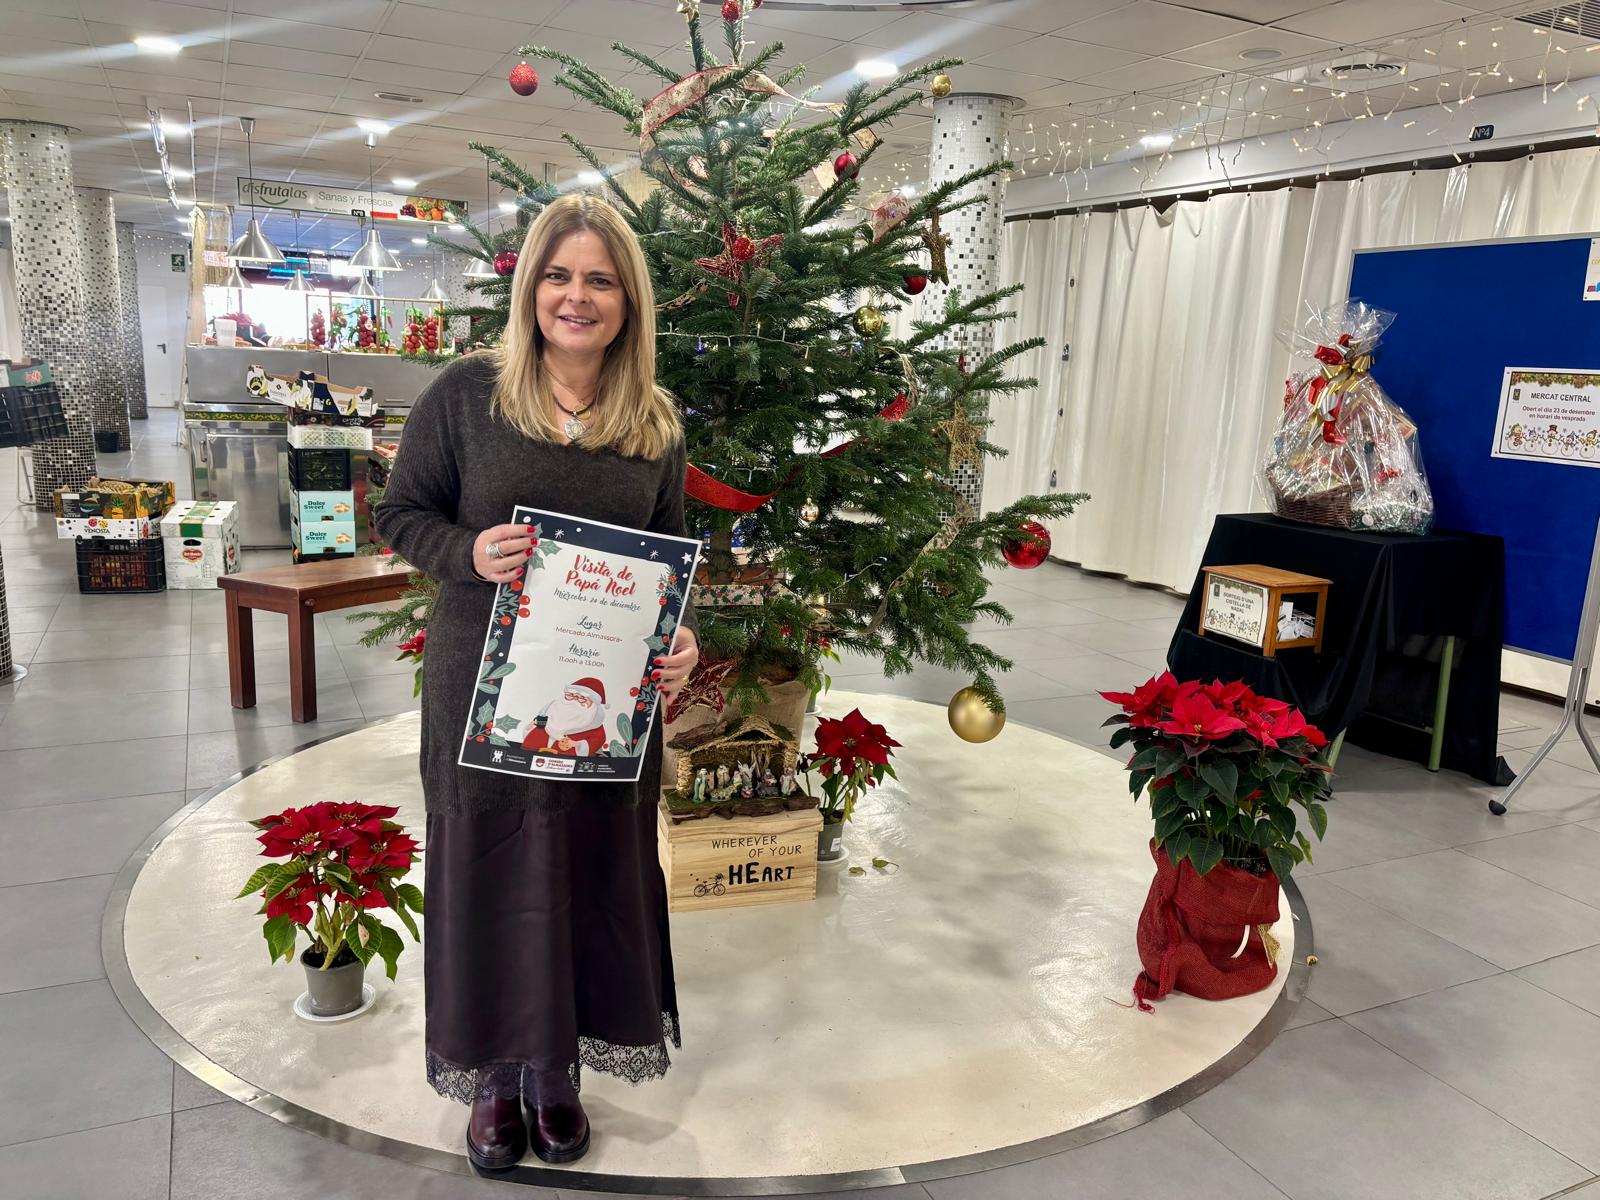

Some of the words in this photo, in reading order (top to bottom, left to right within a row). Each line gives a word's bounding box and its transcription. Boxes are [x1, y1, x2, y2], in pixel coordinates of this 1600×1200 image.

[318, 191, 347, 203] Sanas
[350, 195, 356, 204] y
[357, 195, 393, 208] Frescas
[1530, 392, 1559, 401] MERCAT
[1560, 394, 1592, 403] CENTRAL
[1568, 408, 1596, 416] desembre
[574, 554, 613, 577] Visita
[617, 565, 634, 581] de
[565, 569, 601, 592] Papá
[605, 577, 636, 598] Noel
[599, 597, 608, 606] de
[610, 599, 641, 612] diciembre
[577, 615, 603, 631] Lugar
[568, 643, 601, 659] Horario
[711, 835, 778, 849] WHEREVER
[748, 847, 764, 859] OF
[769, 844, 802, 857] YOUR
[728, 861, 795, 886] HEART
